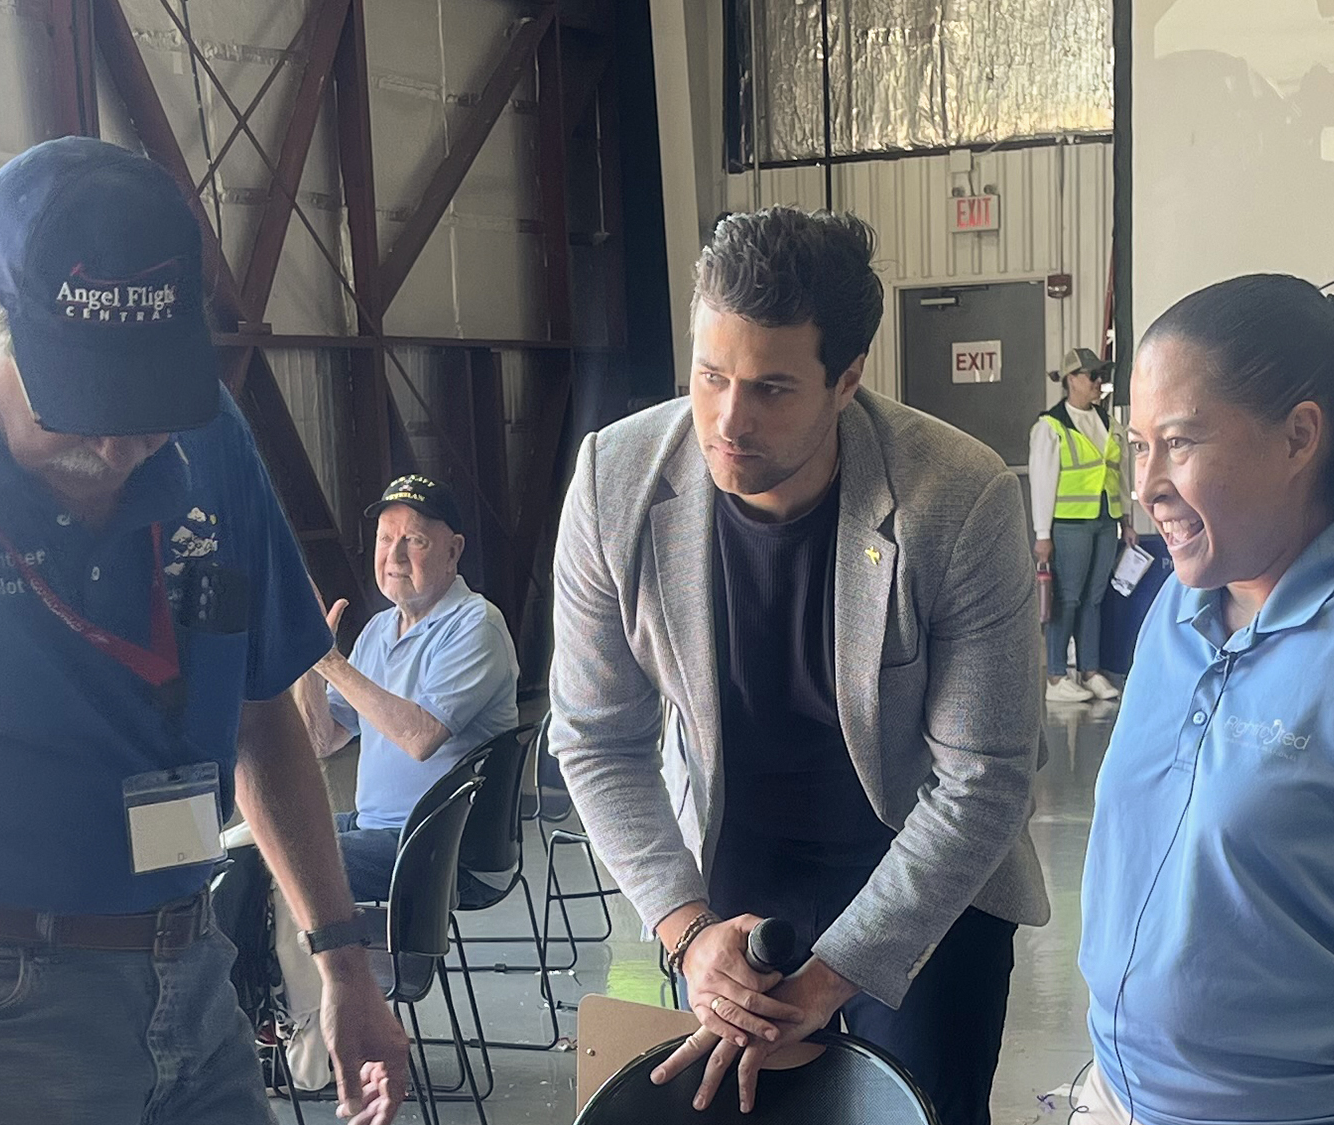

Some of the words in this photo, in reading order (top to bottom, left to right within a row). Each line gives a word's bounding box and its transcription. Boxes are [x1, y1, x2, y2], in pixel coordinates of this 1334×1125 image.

[956, 197, 992, 228] EXIT
[56, 282, 121, 310] Angel
[65, 305, 173, 322] CENTRAL
[956, 352, 997, 371] EXIT
